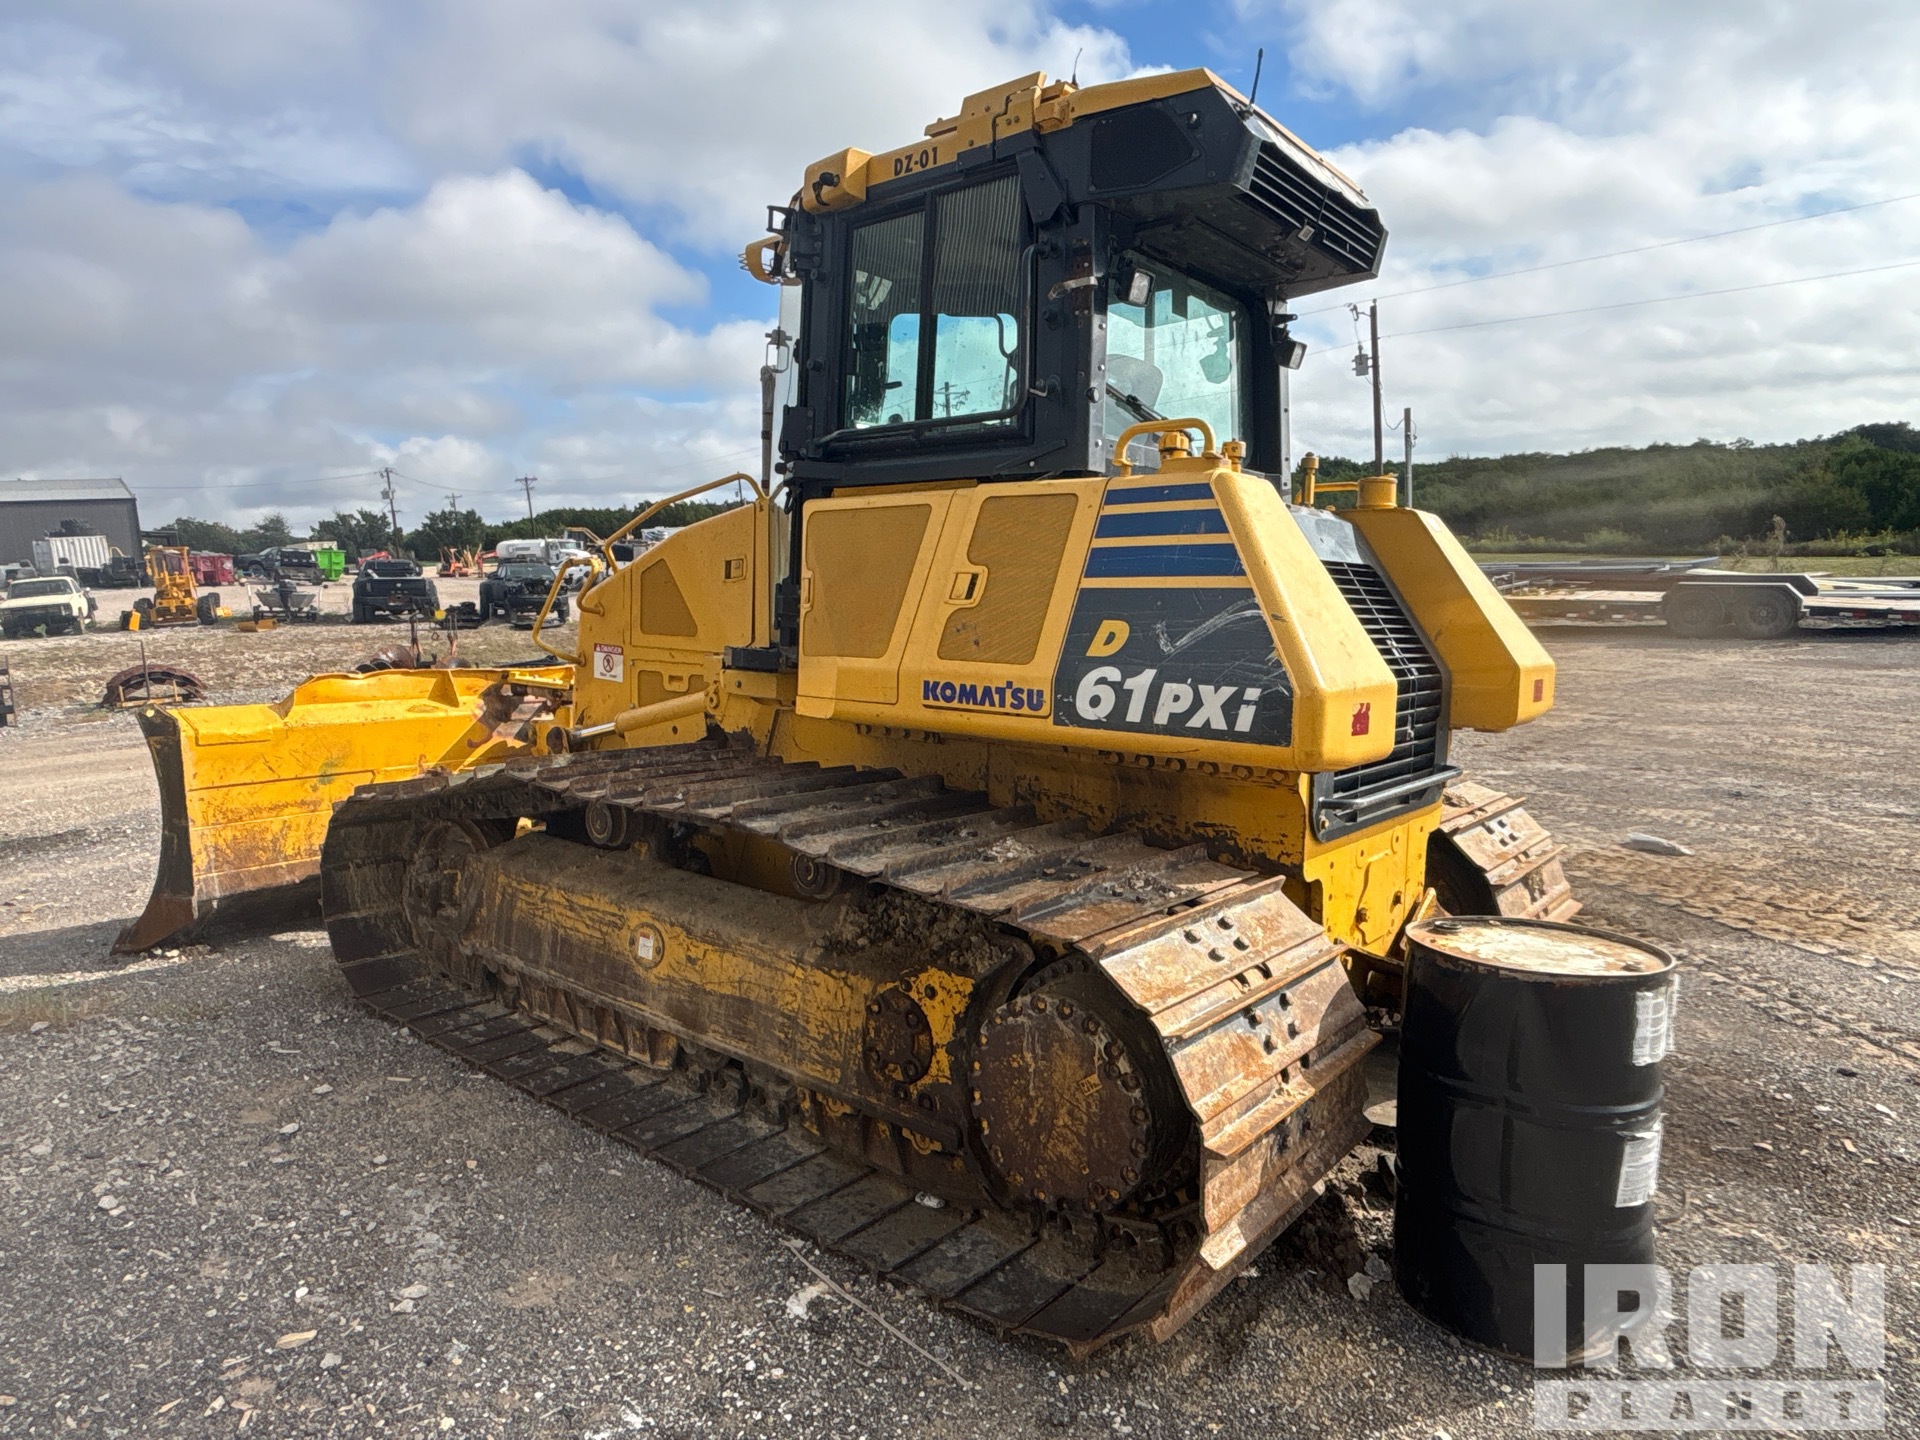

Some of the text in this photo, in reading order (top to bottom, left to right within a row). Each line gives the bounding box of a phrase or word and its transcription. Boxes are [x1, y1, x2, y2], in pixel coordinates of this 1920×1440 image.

[893, 146, 938, 176] DZ-01
[1086, 619, 1130, 657] D
[923, 680, 1044, 711] KOMATSU
